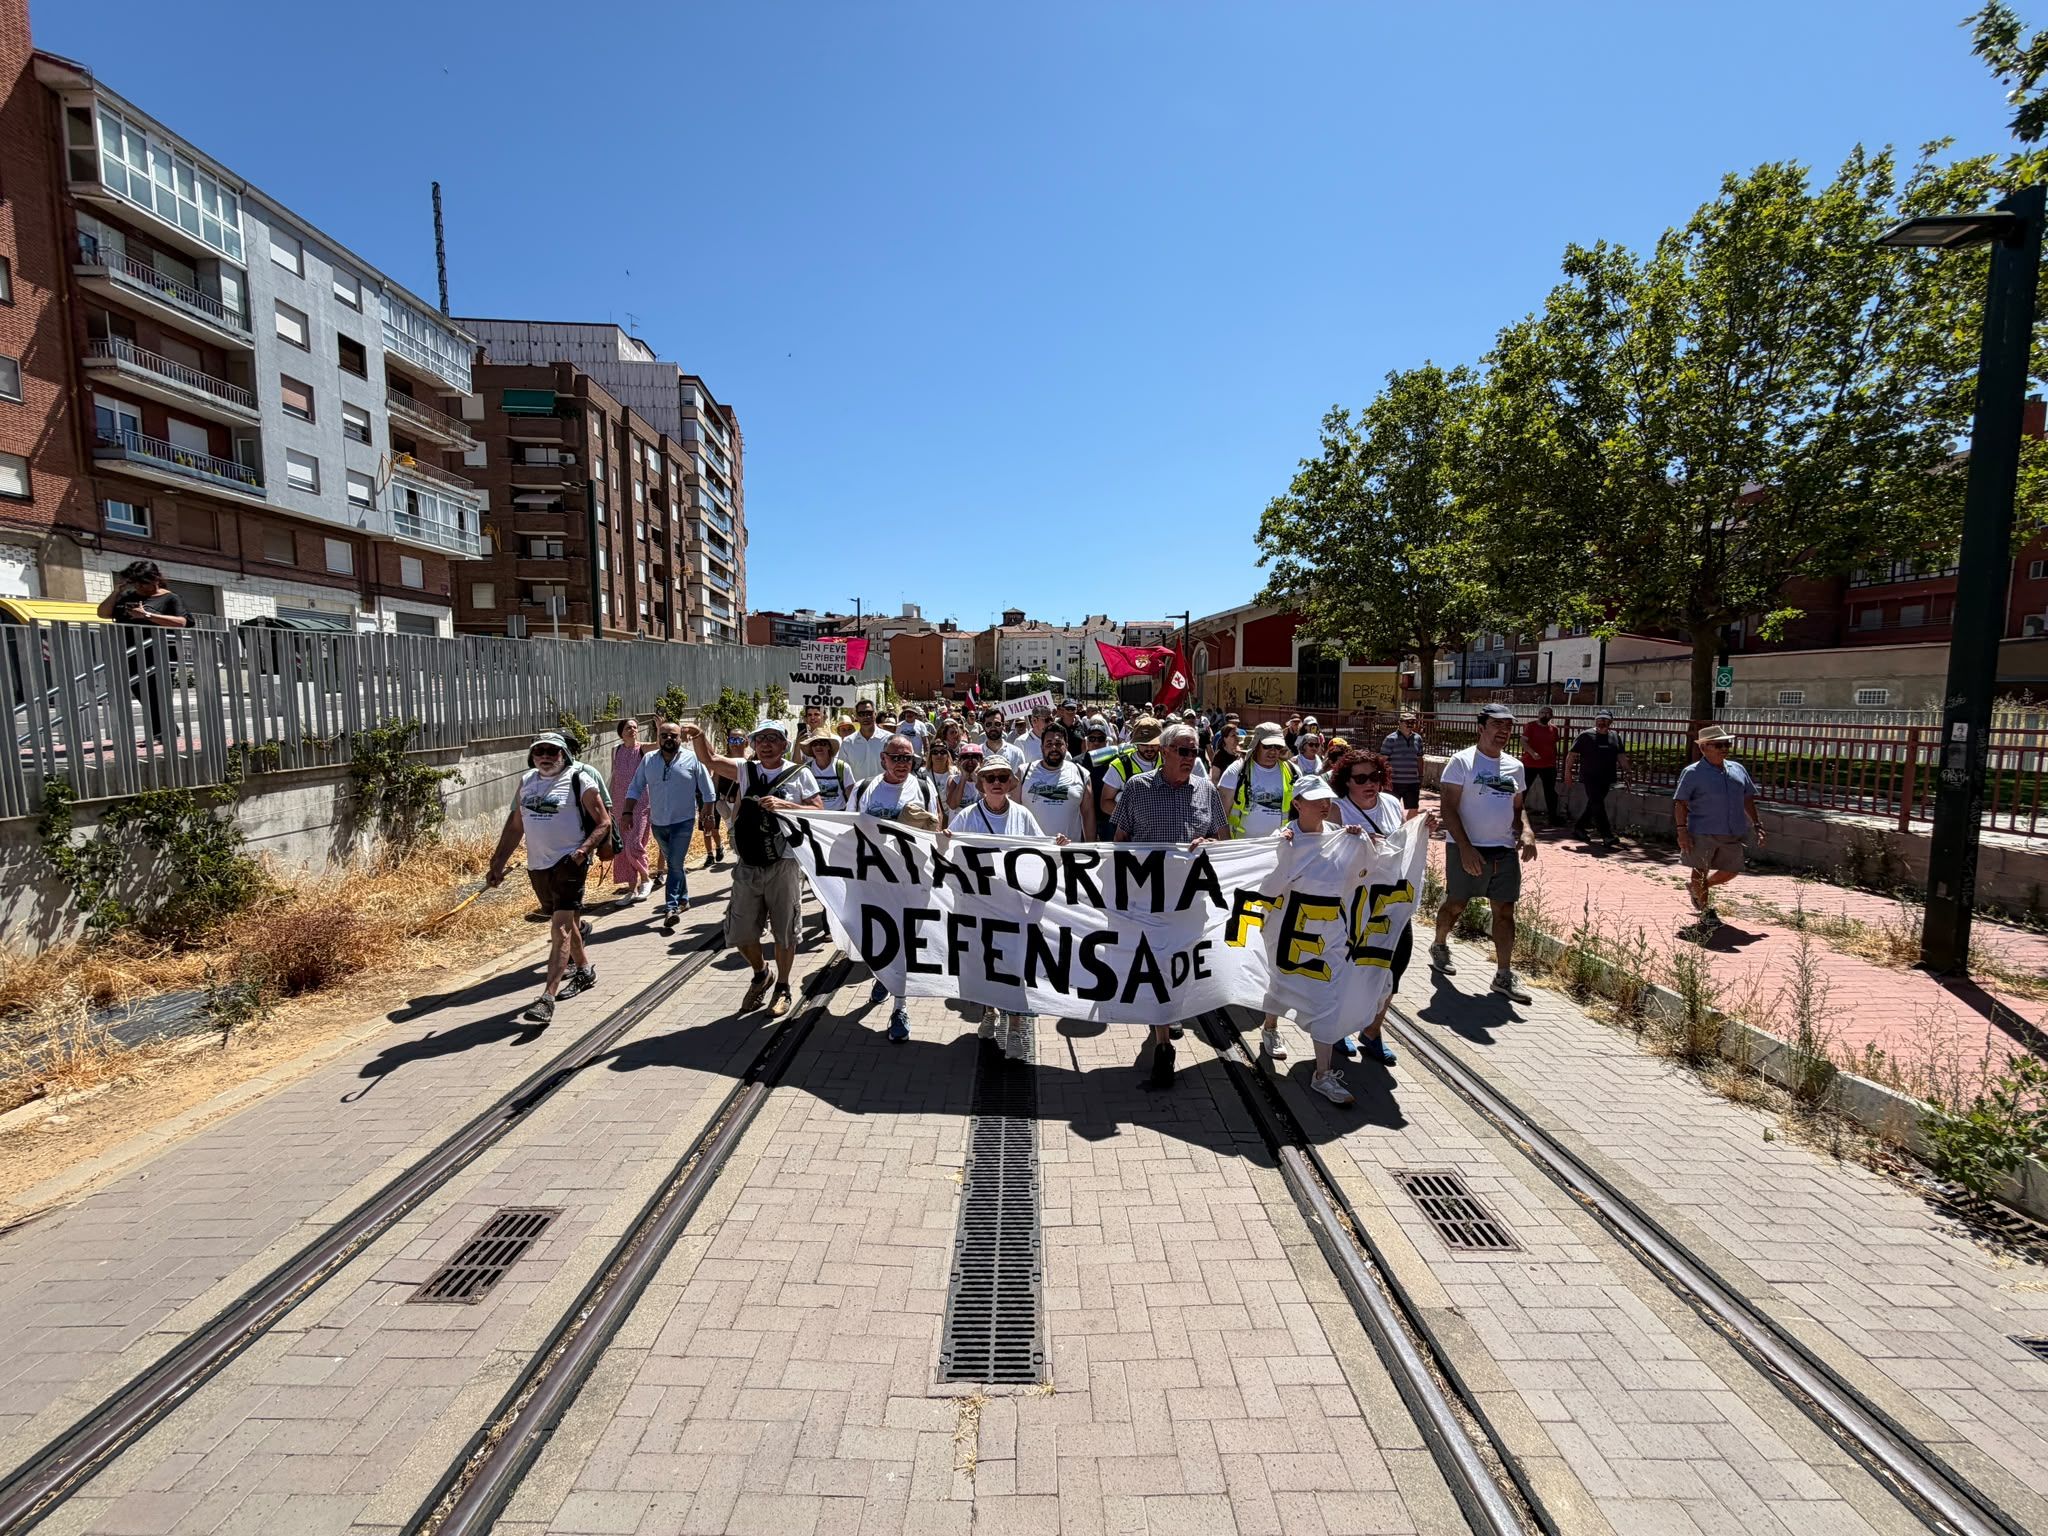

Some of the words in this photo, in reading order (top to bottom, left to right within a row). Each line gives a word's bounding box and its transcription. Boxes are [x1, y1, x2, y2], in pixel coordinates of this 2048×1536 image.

[801, 642, 820, 652] SIN
[823, 644, 847, 653] FEVE
[801, 653, 812, 661] LA
[814, 654, 846, 662] RIBERA
[800, 661, 814, 671] SE
[816, 663, 846, 672] MUERE
[789, 672, 856, 686] VALDERILLA
[817, 685, 832, 696] DE
[803, 694, 844, 706] TORIO
[1008, 695, 1050, 715] VALCUEVA
[861, 904, 1171, 1004] DEFENSA
[1171, 940, 1212, 989] DE
